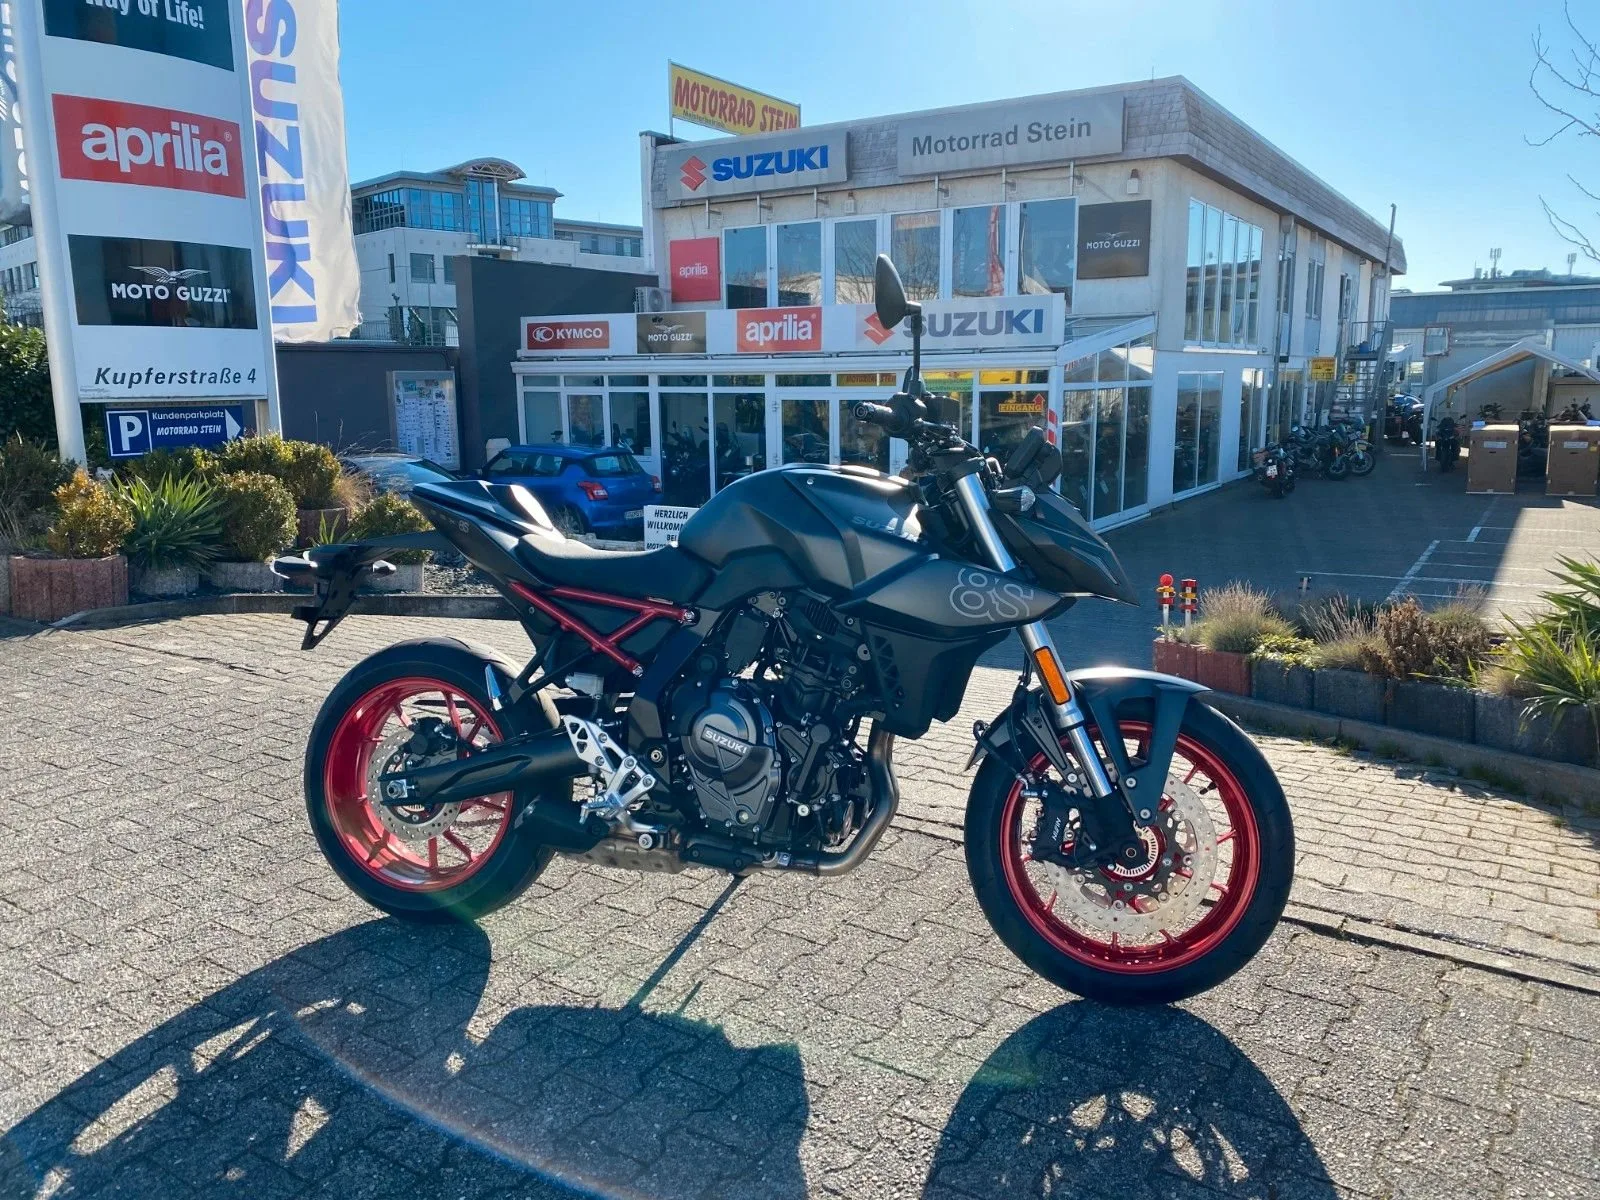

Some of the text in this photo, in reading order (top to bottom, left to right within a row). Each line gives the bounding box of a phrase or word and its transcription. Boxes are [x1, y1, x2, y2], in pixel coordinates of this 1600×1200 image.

[165, 0, 204, 29] Life!
[674, 76, 797, 131] MOTORRAD STEIN
[912, 118, 1091, 156] Motorrad Stein
[82, 121, 229, 177] aprilia
[247, 0, 317, 325] SUZUKI
[713, 145, 829, 182] SUZUKI
[1086, 239, 1141, 250] MOTO GUZZI
[679, 262, 708, 278] aprilia
[112, 283, 229, 303] MOTO GUZZI
[556, 327, 603, 340] KYMCO
[745, 313, 813, 346] aprilia
[903, 308, 1044, 339] SUZUKI
[648, 333, 692, 342] MOTO GUZZI
[95, 367, 257, 389] Kupferstraße 4
[152, 410, 225, 421] Kundenparkplatz
[1000, 403, 1042, 412] EINGANG
[118, 415, 143, 451] P
[156, 424, 221, 436] MOTORRAD STEIN
[654, 509, 689, 520] HERZLICH
[666, 534, 677, 542] BEI
[704, 730, 747, 754] SUZUKI
